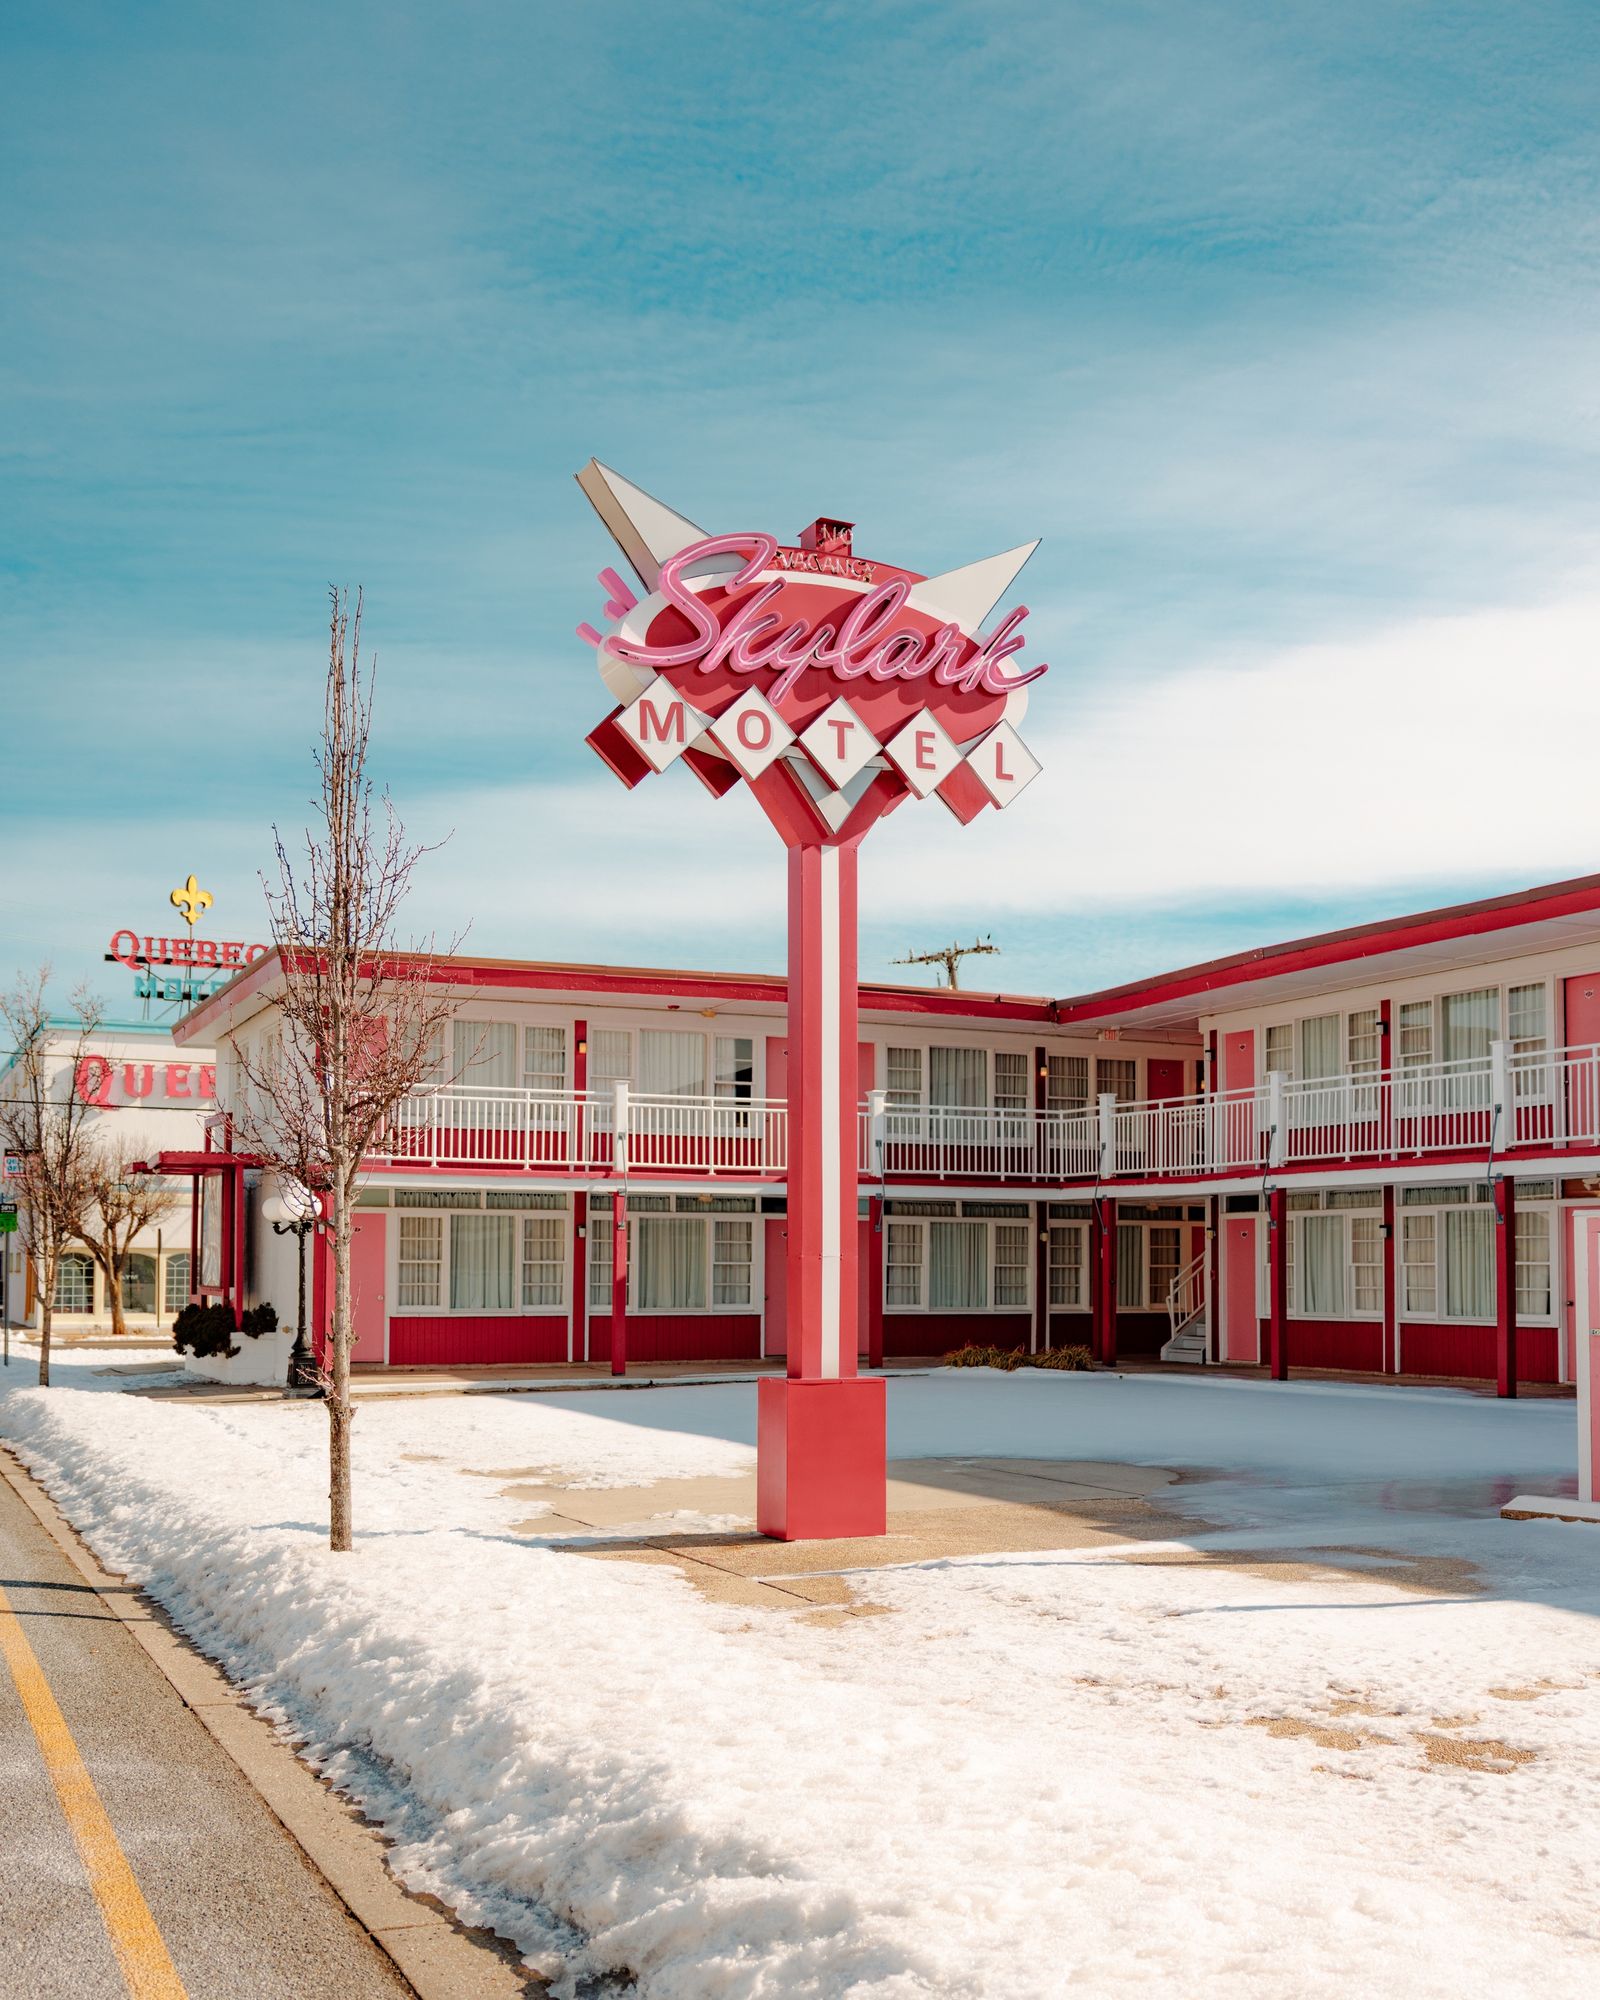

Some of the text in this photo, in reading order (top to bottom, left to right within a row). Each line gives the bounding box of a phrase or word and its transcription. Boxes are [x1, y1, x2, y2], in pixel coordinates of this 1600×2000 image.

[820, 524, 853, 545] NO
[776, 551, 876, 583] VACANCY
[604, 532, 1048, 706] Skylark
[639, 699, 1014, 782] MOTEL
